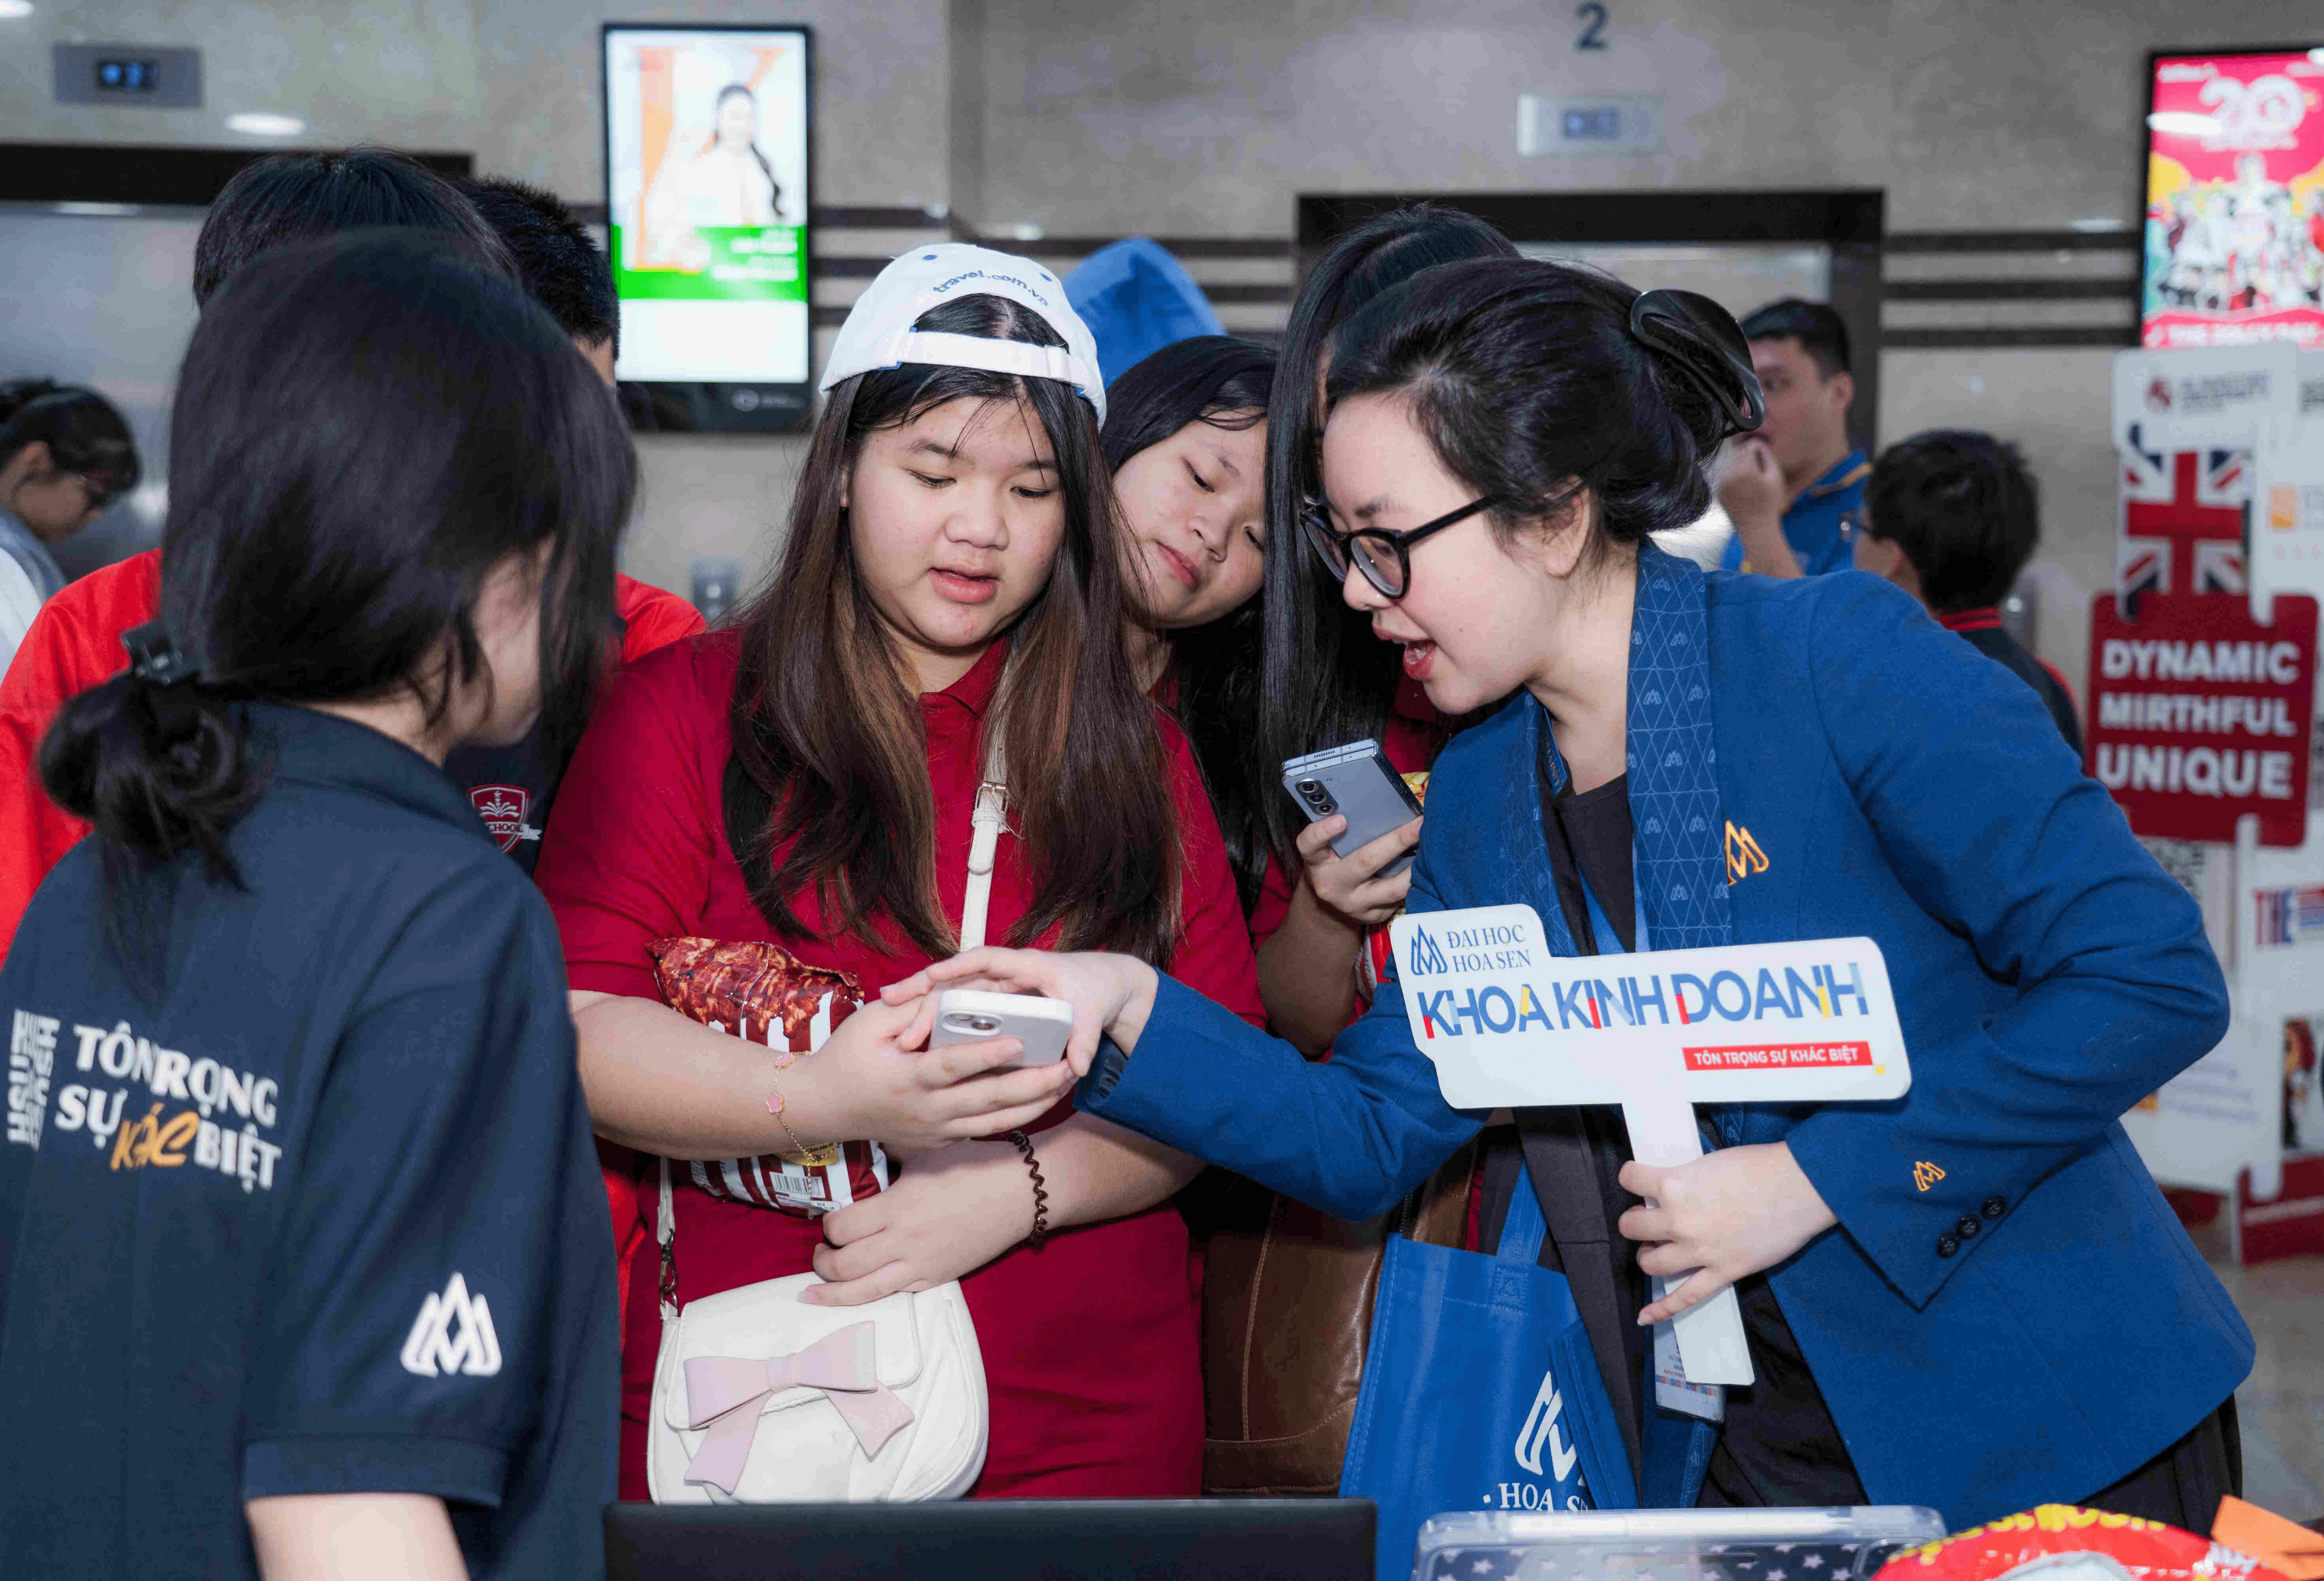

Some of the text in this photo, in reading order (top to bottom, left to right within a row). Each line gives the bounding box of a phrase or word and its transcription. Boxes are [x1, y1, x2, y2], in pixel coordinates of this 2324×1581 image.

[1575, 1, 1611, 51] 2
[2101, 639, 2299, 685] DYNAMIC
[2099, 691, 2296, 738] MIRTHFUL
[2096, 743, 2294, 798] UNIQUE
[1445, 924, 1525, 950] ĐẠI HỌC
[1452, 949, 1531, 973] HOA SEN
[1417, 962, 1869, 1039] KHOA KINH DOANH
[1694, 1045, 1858, 1066] TÔN TRỌNG SỰ KHÁC BIỆT
[194, 1119, 282, 1194] BIỆT
[1498, 1483, 1554, 1511] HOA
